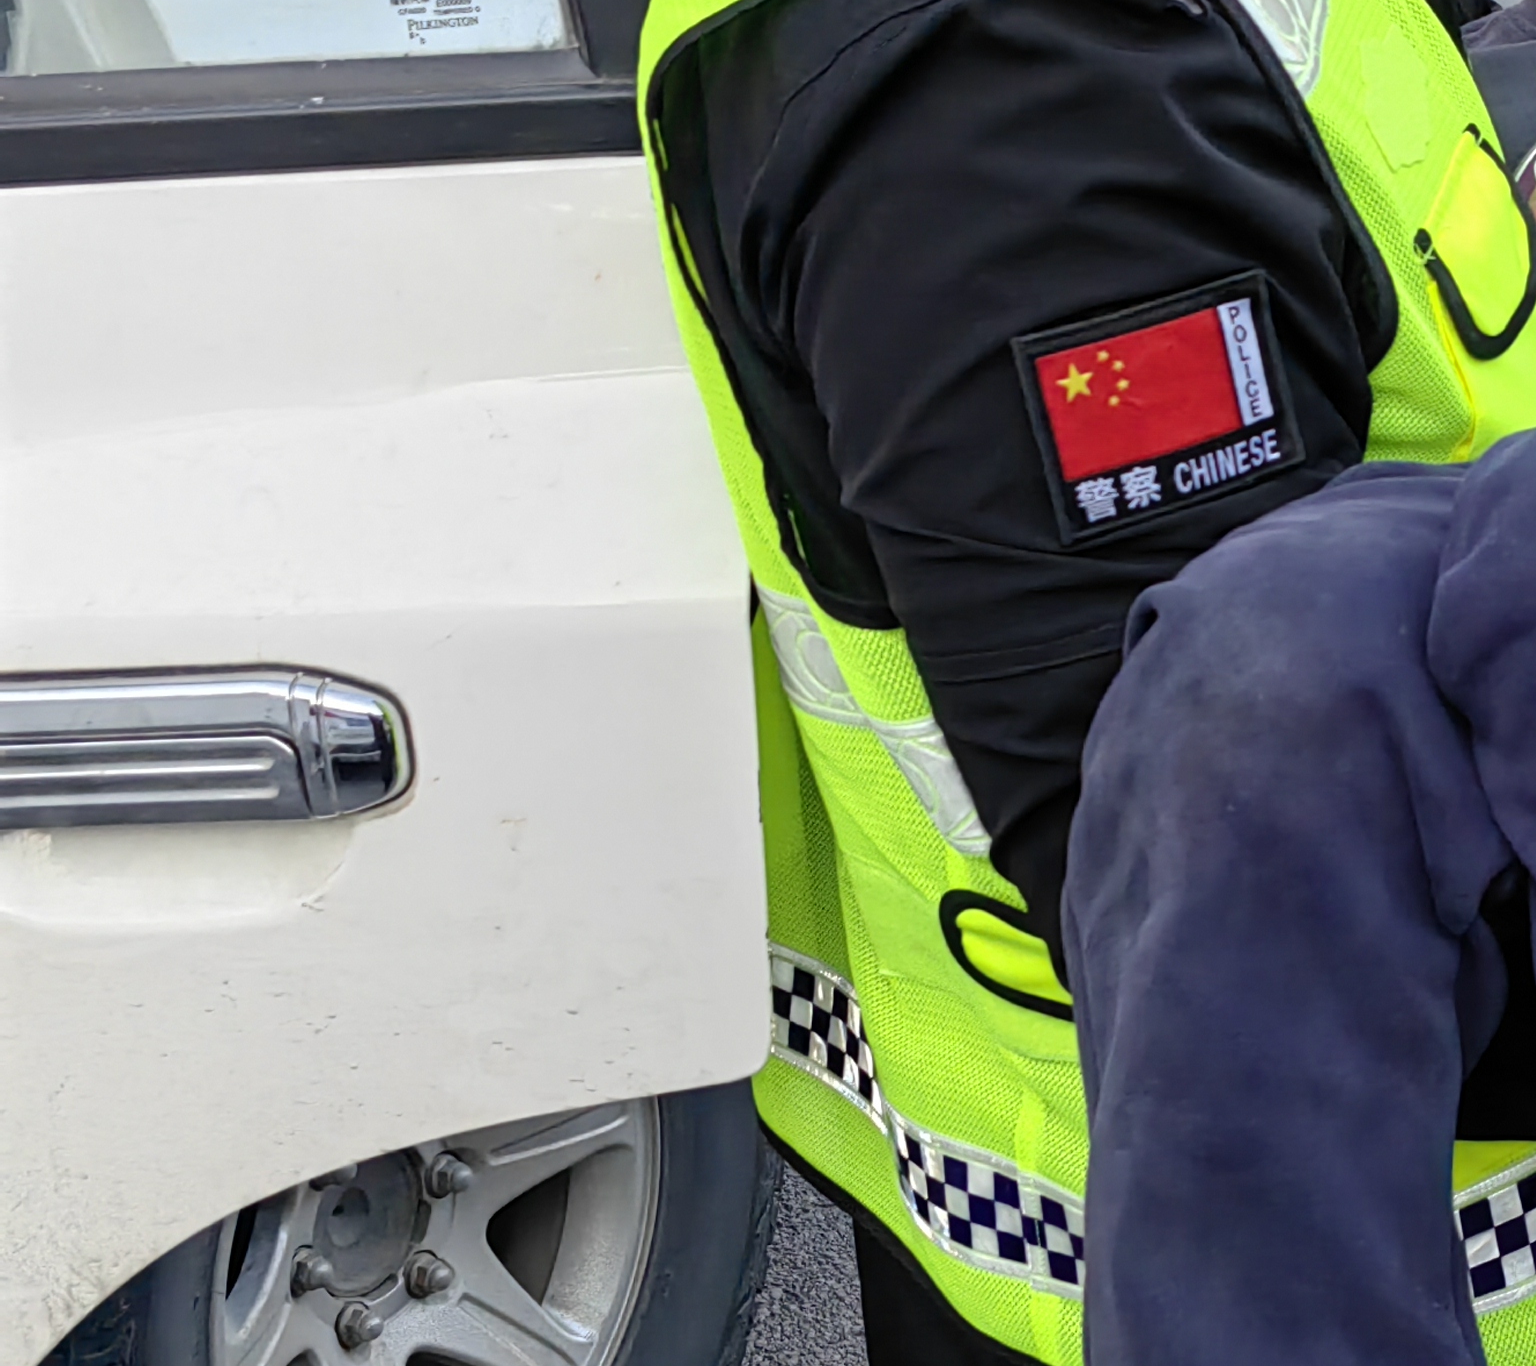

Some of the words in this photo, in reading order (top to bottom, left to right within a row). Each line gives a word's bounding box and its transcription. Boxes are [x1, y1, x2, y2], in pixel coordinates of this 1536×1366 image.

[407, 16, 479, 31] PILKINGTON
[1227, 306, 1263, 418] POLICE
[1173, 429, 1281, 494] CHINESE
[1075, 465, 1162, 523] 警察
